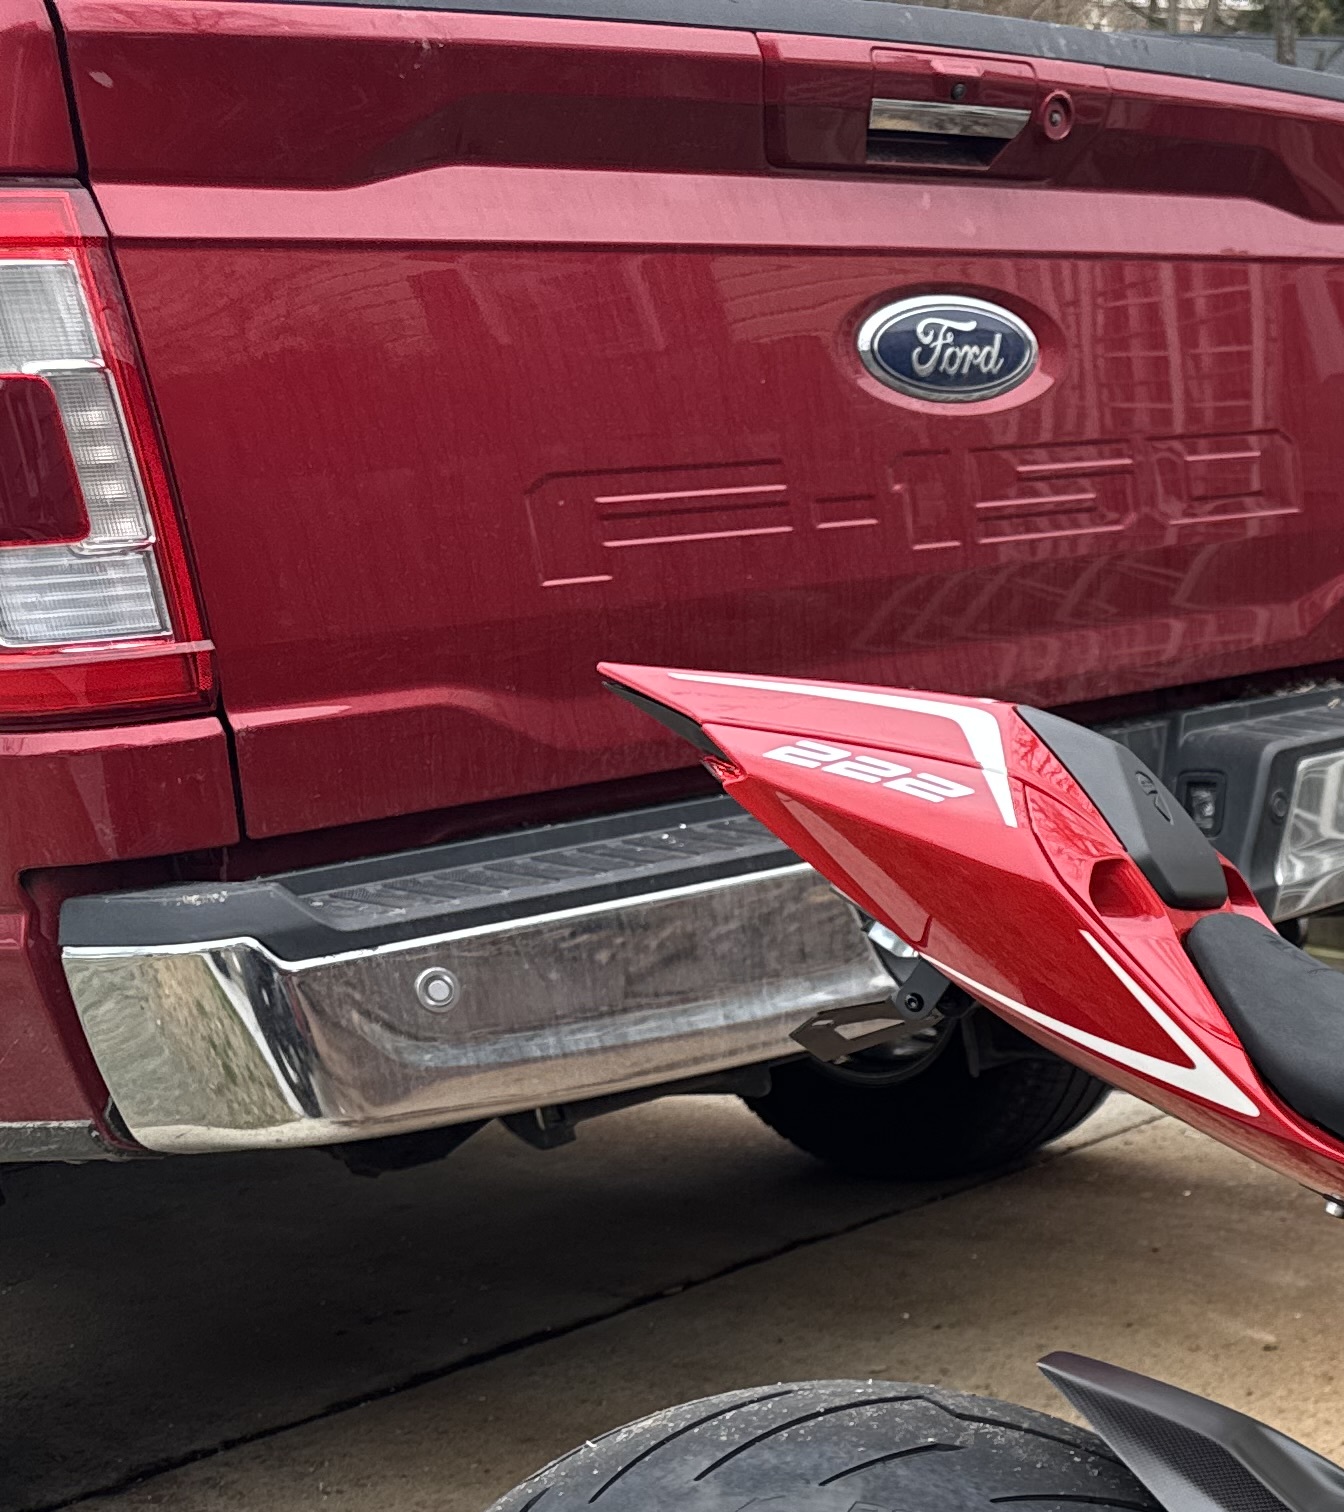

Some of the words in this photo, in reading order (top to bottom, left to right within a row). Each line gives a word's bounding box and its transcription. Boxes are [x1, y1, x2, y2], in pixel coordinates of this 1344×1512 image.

[912, 317, 1004, 377] Ford
[524, 429, 1303, 587] F-150
[762, 739, 976, 803] 222
